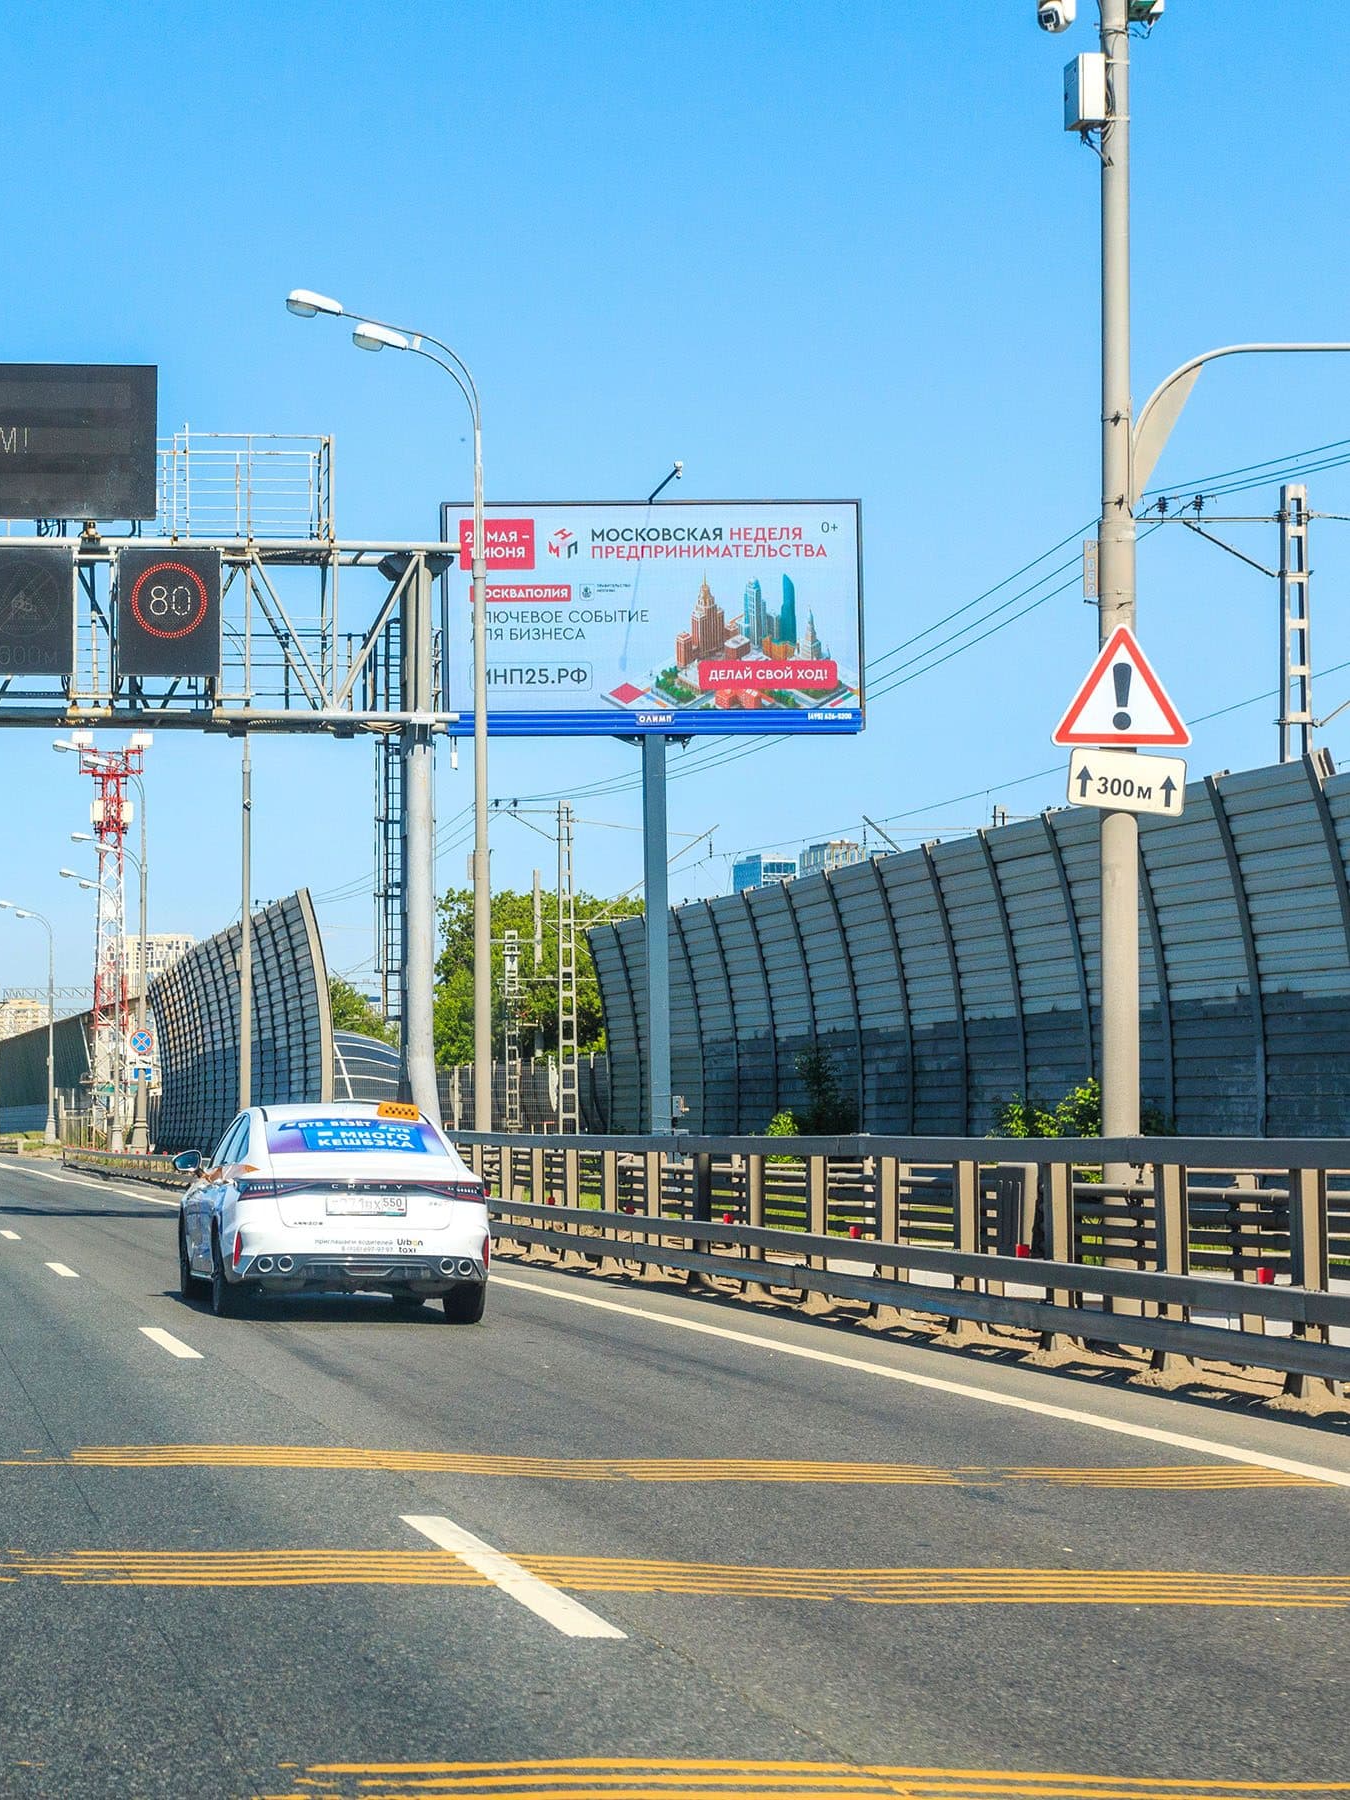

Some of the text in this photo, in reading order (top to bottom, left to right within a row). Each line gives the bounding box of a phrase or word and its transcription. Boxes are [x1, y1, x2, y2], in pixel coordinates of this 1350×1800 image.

[820, 521, 839, 534] 0+
[486, 530, 518, 543] МАЯ
[591, 527, 803, 544] МОСКОВСКАЯ НЕДЕЛЯ
[591, 543, 828, 561] ПРЕДПРИНИМАТЕЛЬСТВА
[482, 588, 569, 599] ОСКВАПОЛИЯ
[149, 585, 191, 616] 80
[471, 610, 650, 624] ЛЮЧЕВОЕ СОБЫТИЕ
[509, 627, 586, 641] БИЗНЕСА
[709, 667, 828, 682] ДЕЛАЙ СВОЙ ХОД!
[638, 714, 673, 724] ОЛИМП
[340, 1131, 411, 1141] МНОГО
[317, 1138, 415, 1149] КЕШБЭКА
[383, 1198, 403, 1208] 550
